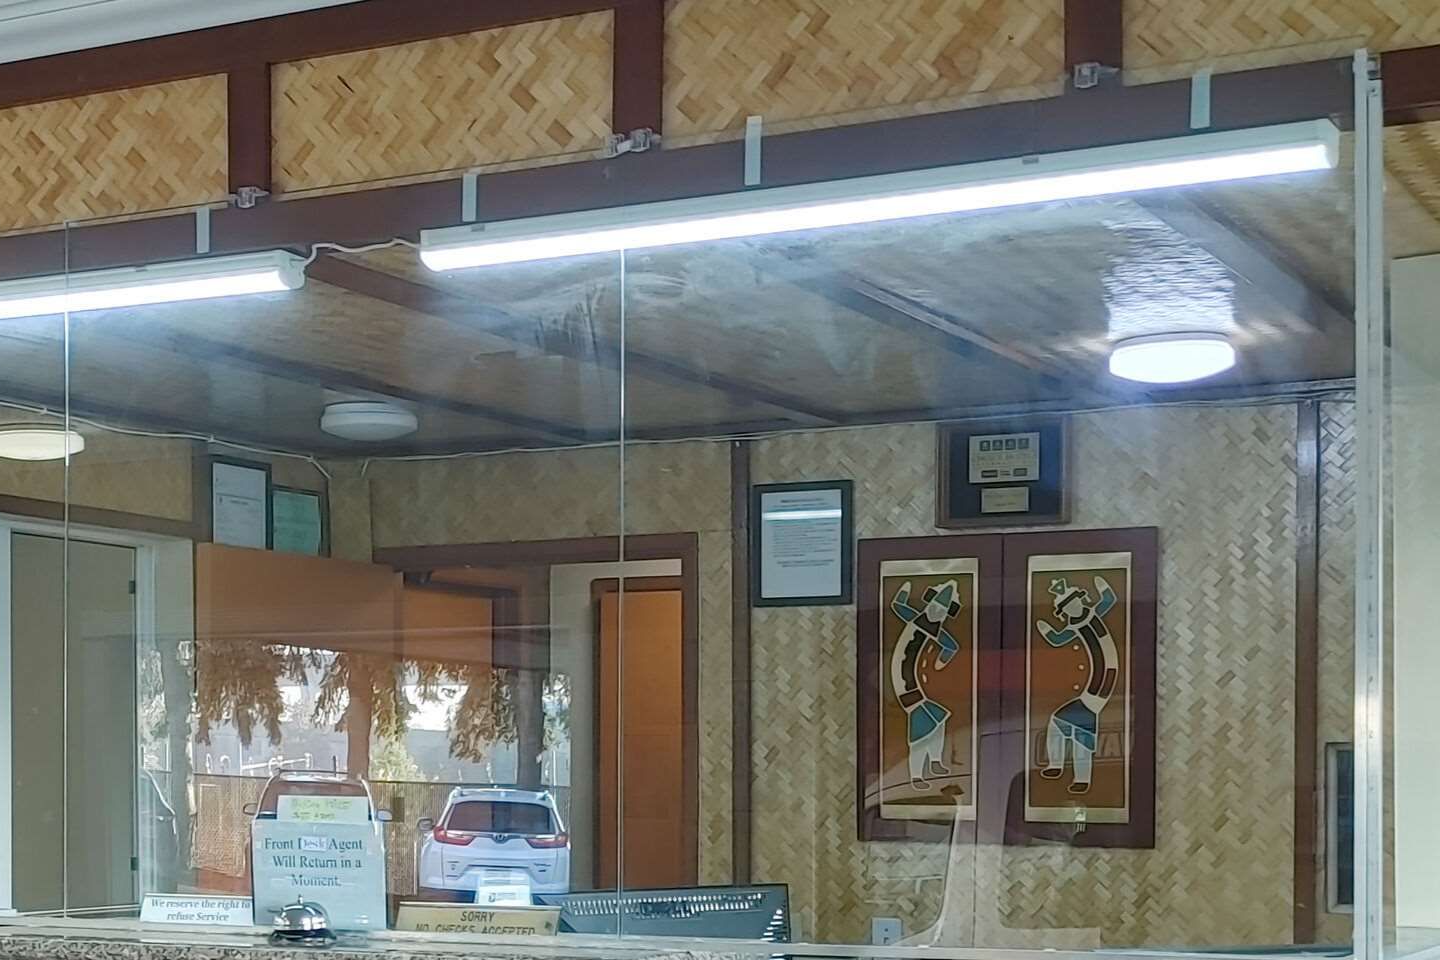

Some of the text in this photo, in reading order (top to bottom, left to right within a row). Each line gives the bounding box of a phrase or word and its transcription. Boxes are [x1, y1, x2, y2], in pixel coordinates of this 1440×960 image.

[264, 838, 293, 850] Front
[329, 838, 363, 852] Agent
[273, 856, 362, 868] Will Return in a
[151, 899, 251, 911] We reserve the right to
[166, 911, 230, 921] refuse Service
[460, 911, 496, 922] SORRY
[481, 925, 535, 936] ACCEPTED
